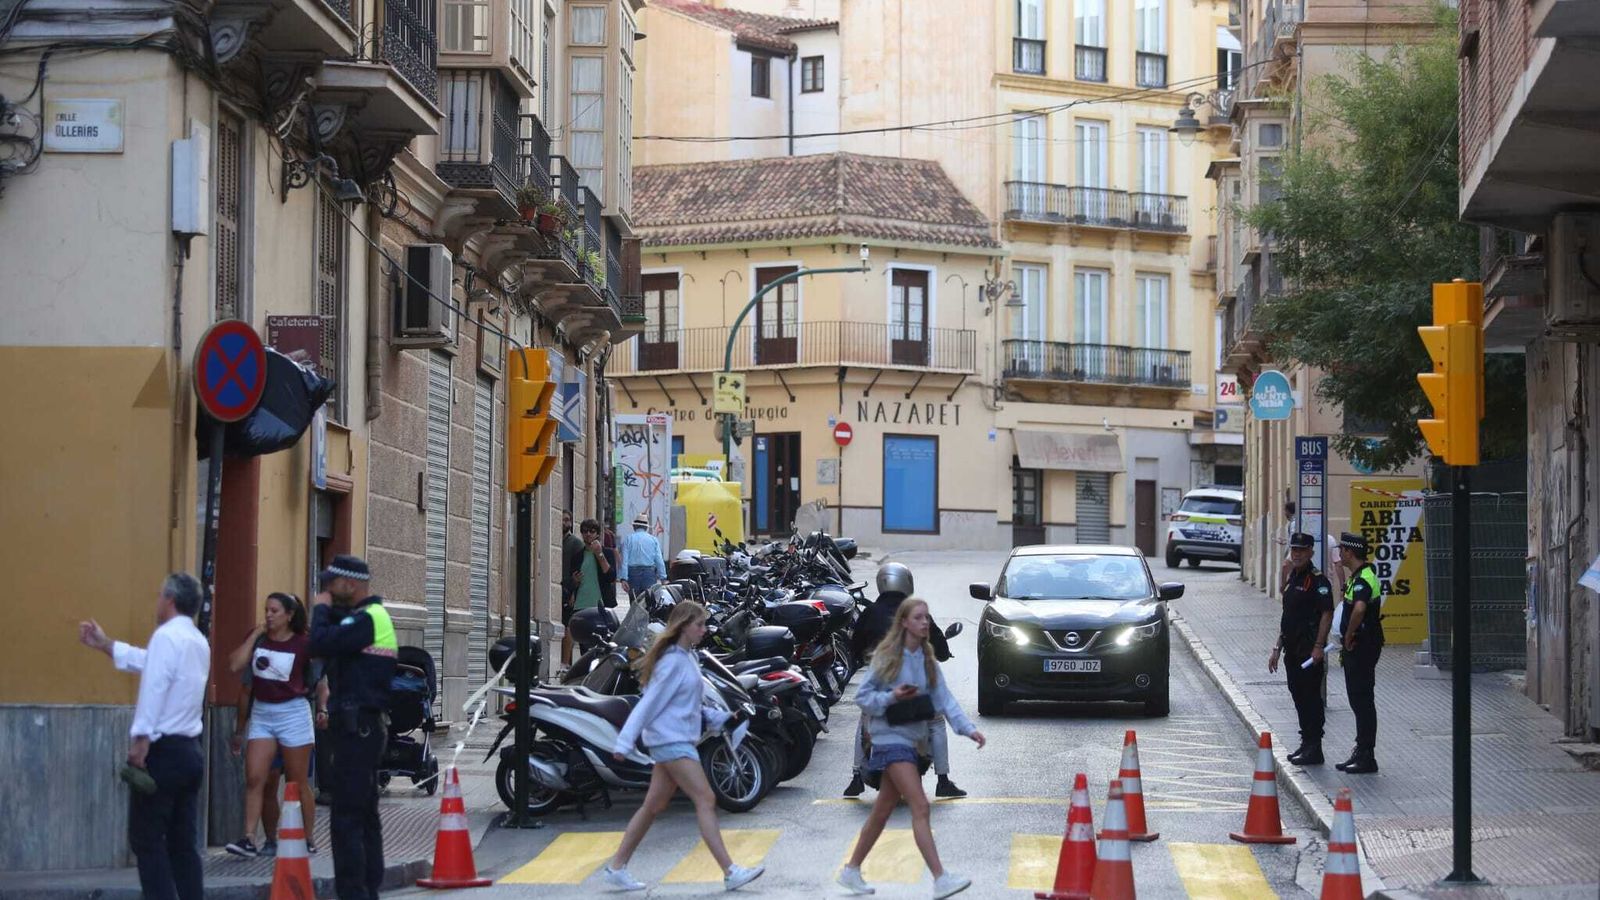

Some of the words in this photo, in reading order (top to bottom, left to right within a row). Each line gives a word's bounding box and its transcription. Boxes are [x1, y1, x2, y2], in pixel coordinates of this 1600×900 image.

[719, 376, 727, 390] P
[857, 400, 961, 426] NAZARET
[1214, 409, 1229, 430] P
[1301, 441, 1322, 456] BUS
[1303, 474, 1318, 485] 36
[1361, 510, 1402, 526] ABI
[1361, 527, 1424, 543] ERTA
[1380, 579, 1411, 596] AS
[1051, 661, 1076, 671] 9760
[1080, 661, 1099, 671] JDZ
